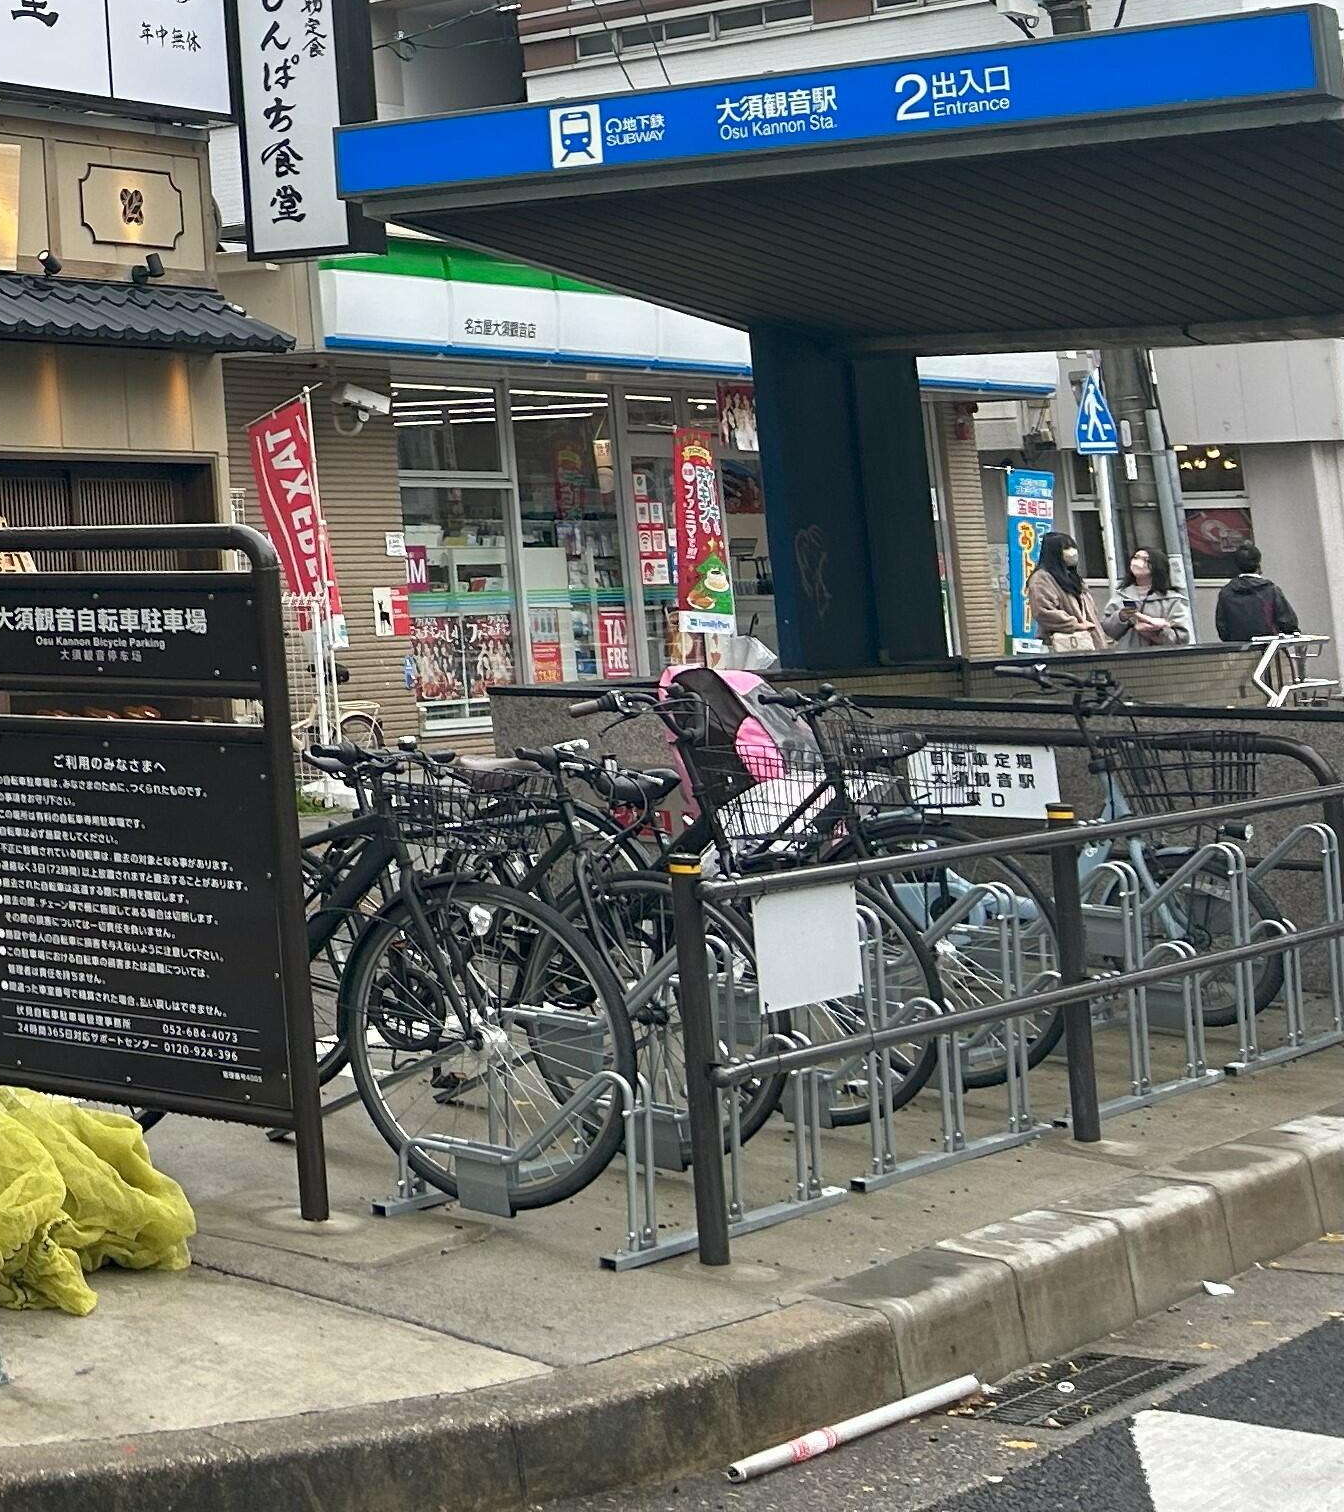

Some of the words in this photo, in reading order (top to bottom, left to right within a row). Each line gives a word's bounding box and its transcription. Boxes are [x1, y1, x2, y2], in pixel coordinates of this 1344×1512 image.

[138, 21, 202, 53] 年中無休
[931, 65, 1011, 100] 出入口
[716, 85, 838, 124] 大須観音駅
[894, 73, 930, 121] 2
[933, 97, 1011, 117] Entrance
[623, 113, 665, 132] 地下鉄
[720, 123, 749, 141] Osu
[752, 118, 806, 137] Kannon
[809, 114, 838, 130] Sta.
[606, 130, 665, 147] SUBWAY
[464, 317, 537, 339] 名古屋大須観音店
[35, 636, 54, 646] Osu
[56, 636, 91, 647] Kannon
[93, 637, 127, 649] Bicycle
[129, 638, 165, 650] Parking
[53, 753, 167, 773] ご利用のみなさまへ
[162, 1023, 238, 1044] 052-684-4073
[163, 1041, 239, 1063] 0120-924-396
